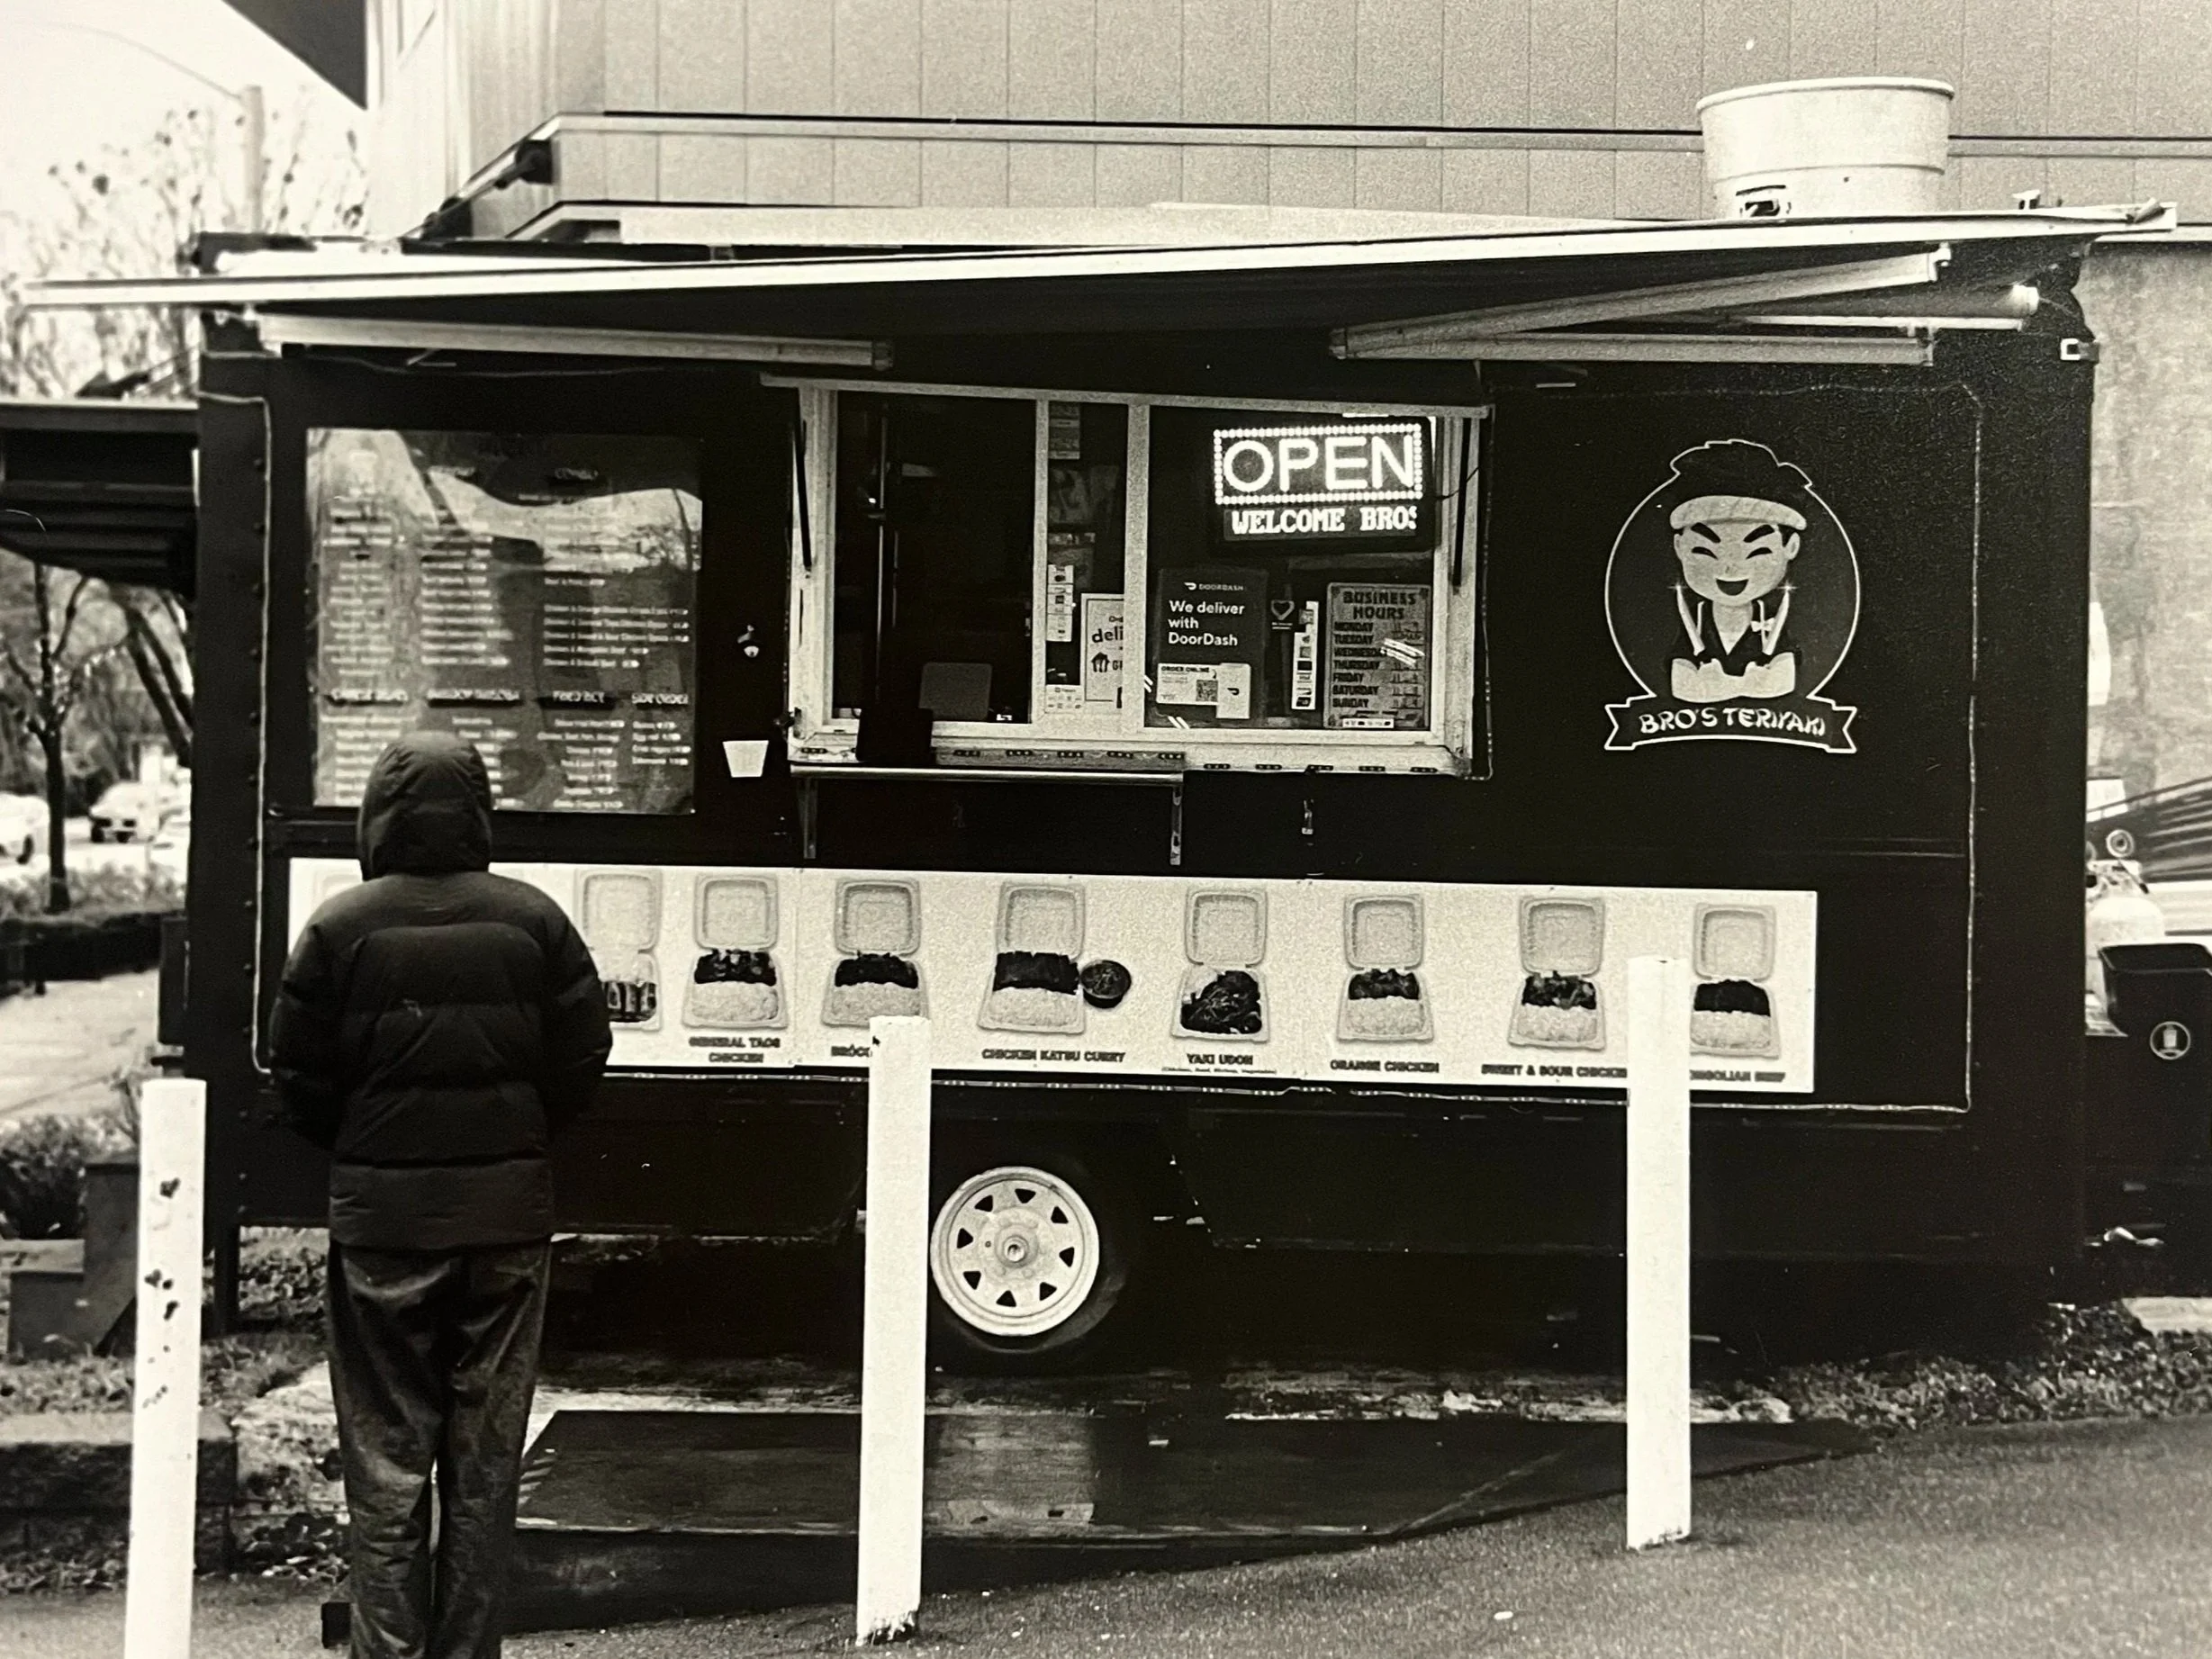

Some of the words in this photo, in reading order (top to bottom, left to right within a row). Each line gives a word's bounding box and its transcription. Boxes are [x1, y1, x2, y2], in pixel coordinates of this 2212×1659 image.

[1223, 436, 1413, 492] OPEN
[1232, 508, 1345, 534] WELCOME
[1342, 591, 1416, 605] BUSINESS
[1169, 600, 1194, 613] We
[1196, 600, 1245, 615] deliver
[1353, 606, 1405, 620] HOURS
[1168, 616, 1199, 629] with
[1169, 631, 1239, 646] DoorDash
[1639, 707, 1718, 735] BRO'S
[1722, 707, 1827, 736] TERIYAKI
[709, 1052, 764, 1063] CHICKEN
[981, 1049, 1037, 1060] CHICKEN
[1084, 1051, 1126, 1062] CURRY
[1187, 1053, 1215, 1065] YAKI
[1218, 1054, 1253, 1066] UDON
[1330, 1059, 1381, 1071] ORANGE
[1384, 1060, 1440, 1073] CHICKEN
